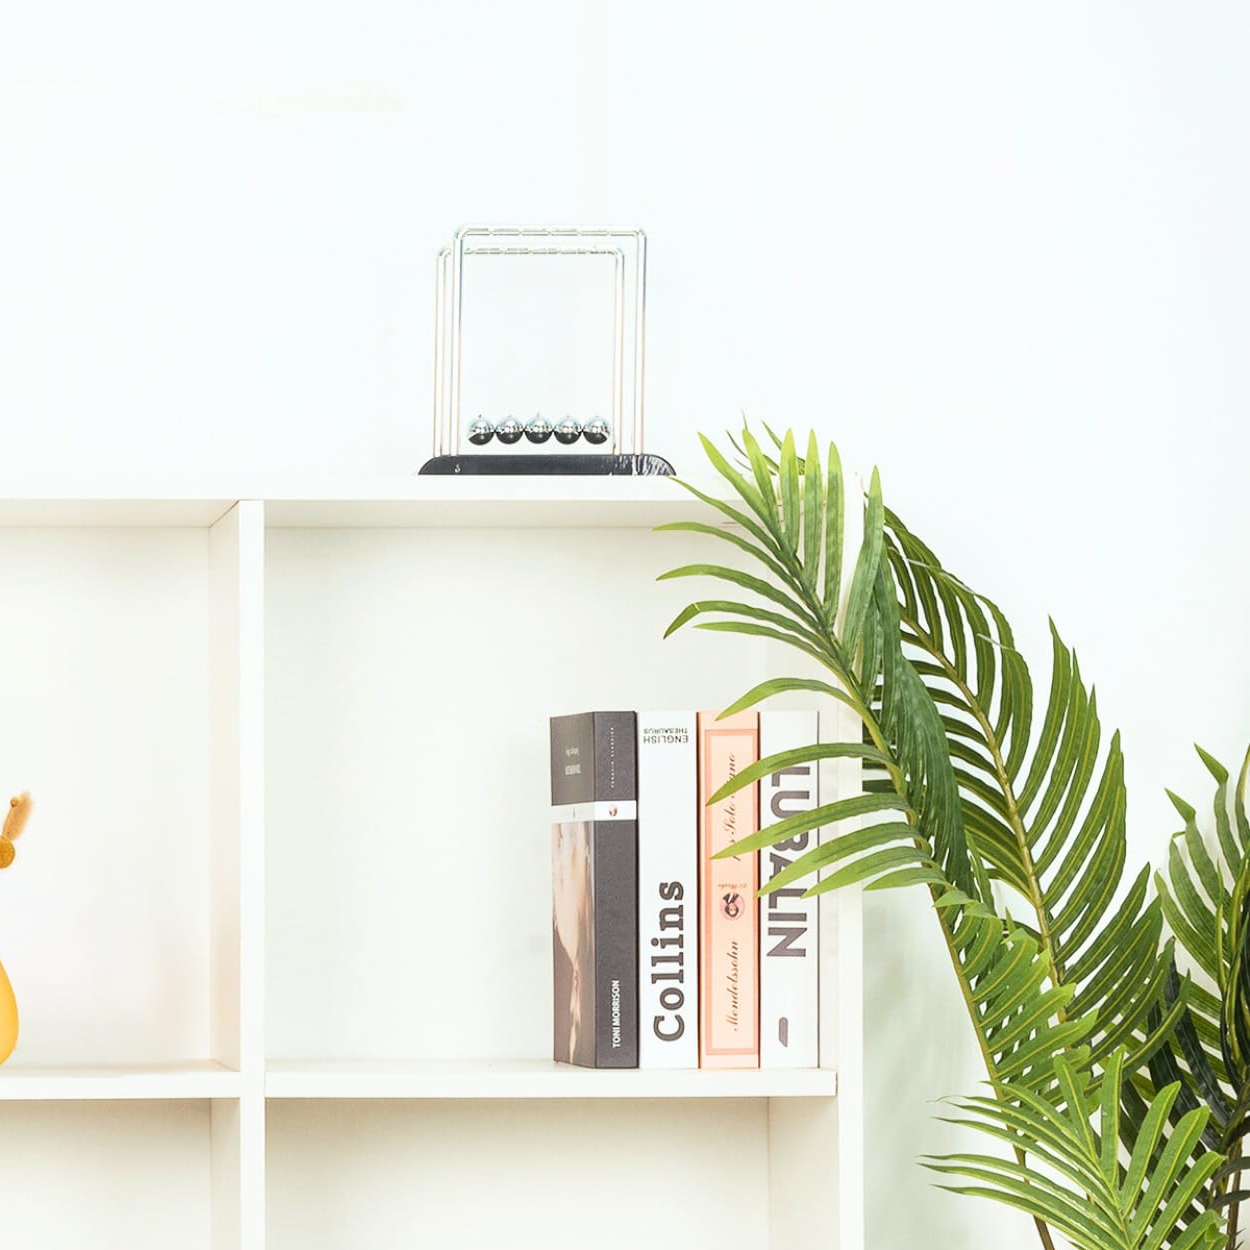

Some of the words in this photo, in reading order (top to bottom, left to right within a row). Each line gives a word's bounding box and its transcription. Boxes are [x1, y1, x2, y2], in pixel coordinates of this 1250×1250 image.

[643, 735, 689, 744] ENGLISH
[651, 881, 684, 1041] Collins
[611, 979, 620, 1026] MORRISON
[726, 941, 738, 1031] Mendelssohn
[612, 1027, 621, 1048] TONI
